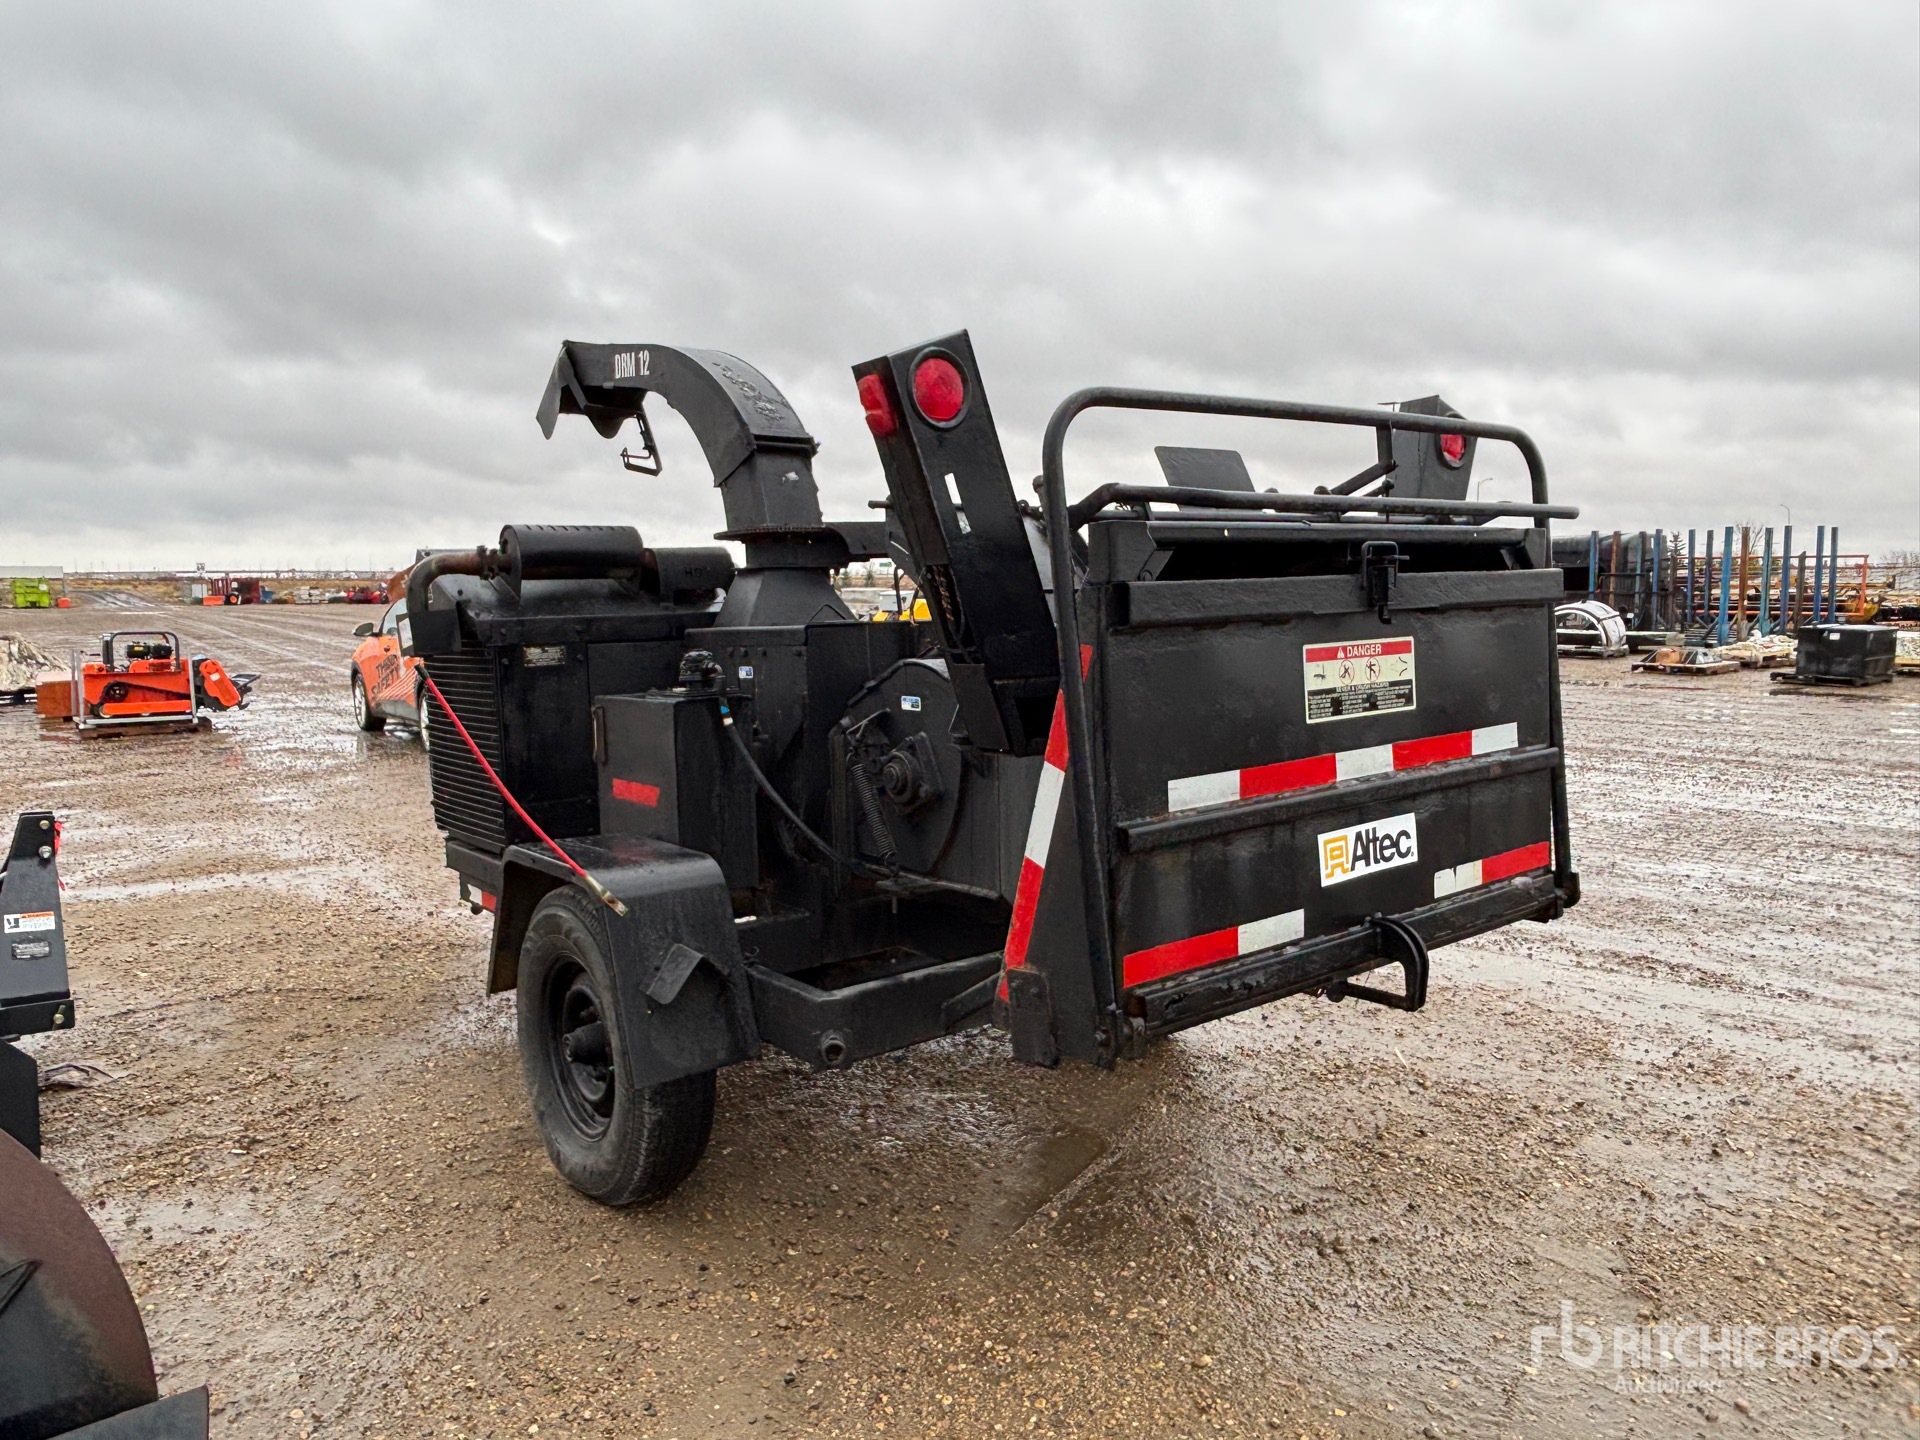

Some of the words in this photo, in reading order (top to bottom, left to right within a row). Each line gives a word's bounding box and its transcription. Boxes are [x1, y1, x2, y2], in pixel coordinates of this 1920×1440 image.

[614, 352, 636, 379] DRM
[638, 349, 650, 376] 12
[1346, 643, 1382, 657] DANGER
[1350, 826, 1412, 872] Altec
